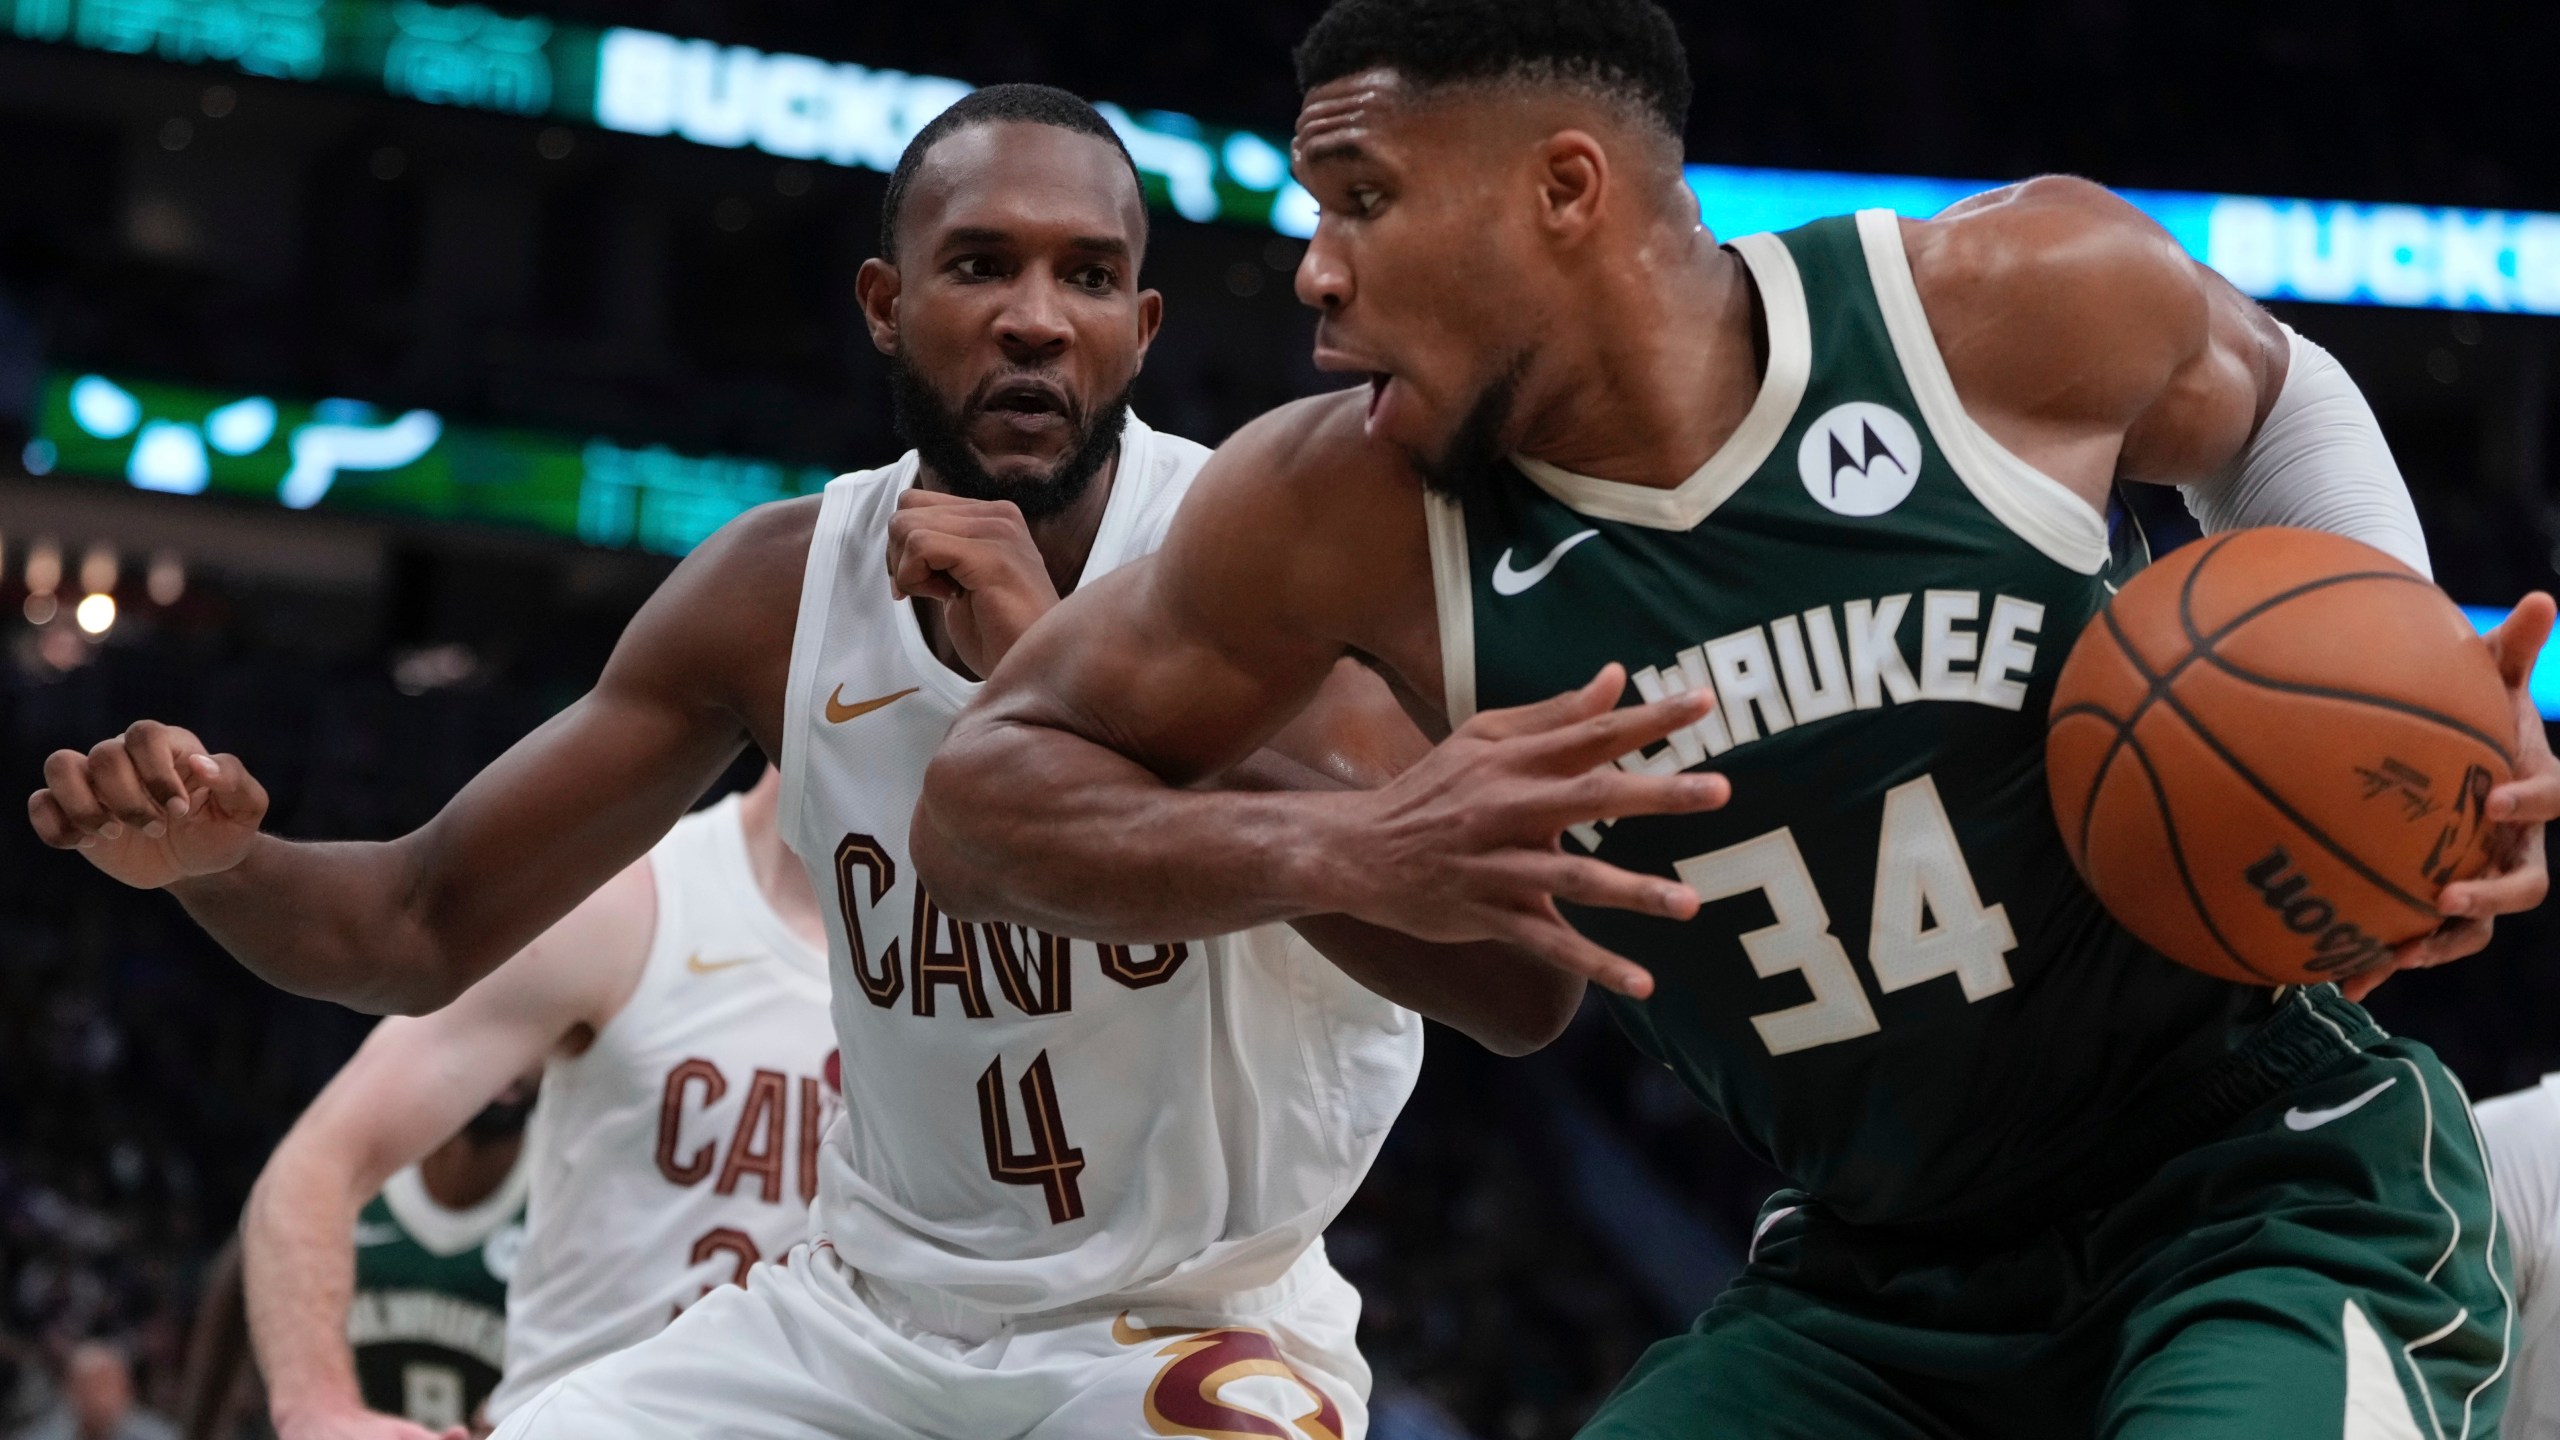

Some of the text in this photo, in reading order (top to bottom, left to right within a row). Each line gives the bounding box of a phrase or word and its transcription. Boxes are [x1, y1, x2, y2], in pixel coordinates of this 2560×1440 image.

[1562, 589, 2046, 853] WAUKEE
[1672, 773, 2019, 1056] 34
[2244, 845, 2392, 981] ilson
[976, 1048, 1086, 1226] 4
